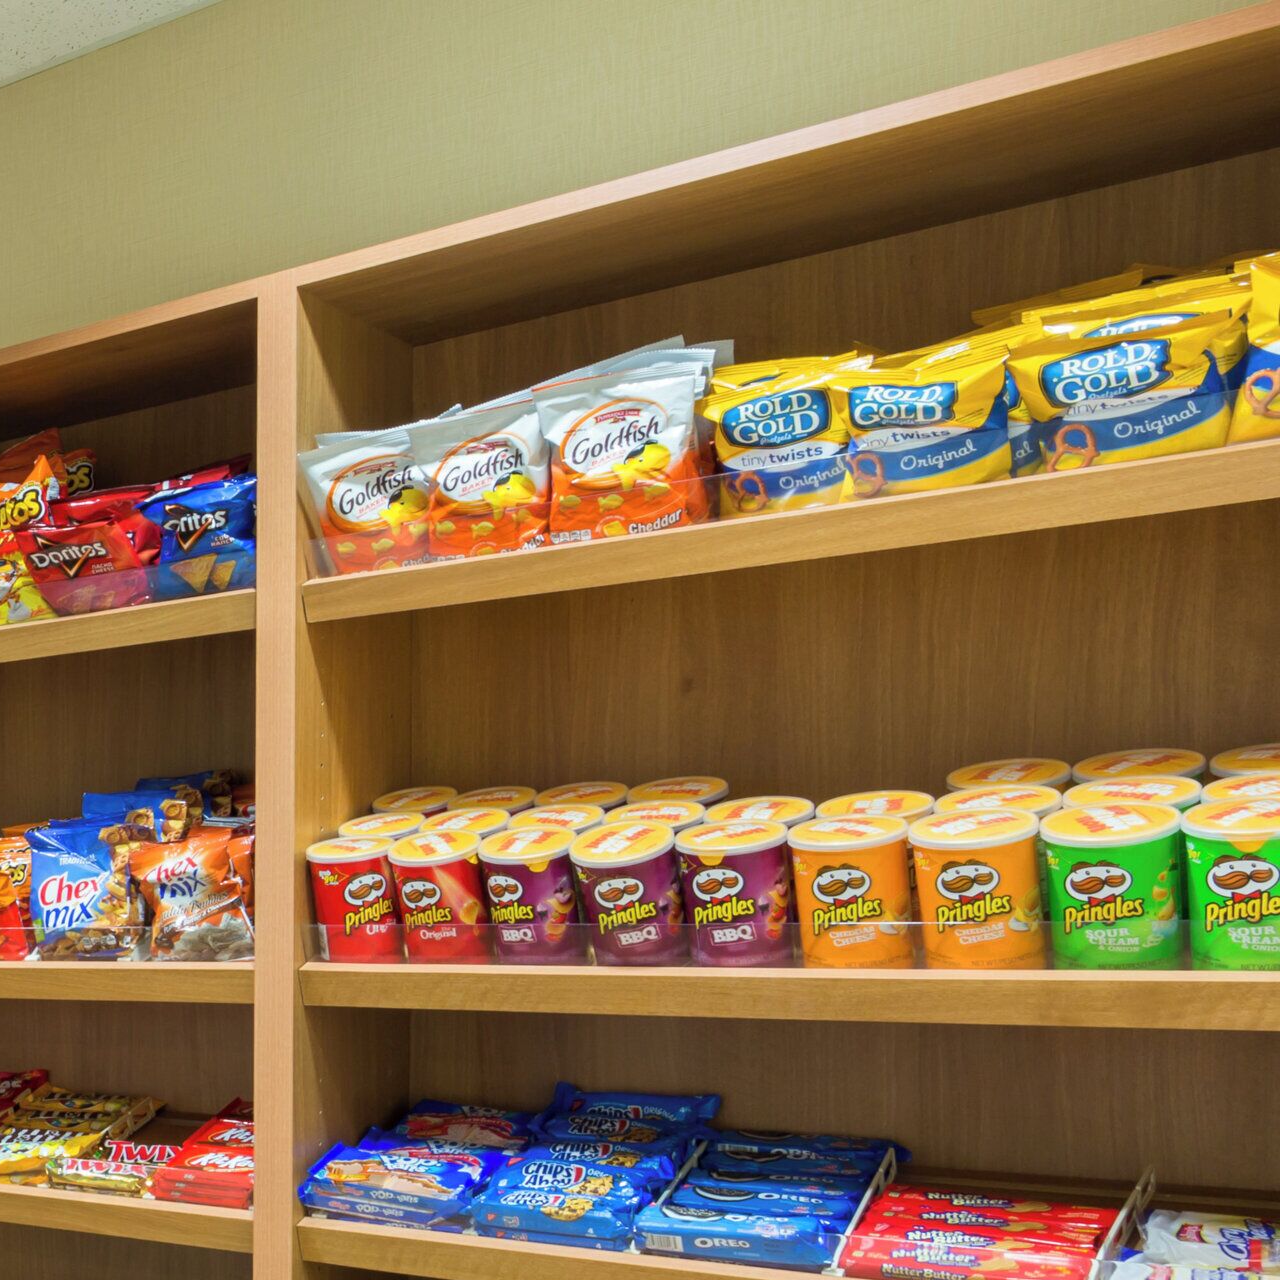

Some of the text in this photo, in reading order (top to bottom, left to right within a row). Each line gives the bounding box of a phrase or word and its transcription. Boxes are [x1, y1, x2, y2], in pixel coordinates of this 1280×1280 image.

[1061, 343, 1153, 378] ROLD
[864, 385, 940, 403] ROLD
[1055, 362, 1159, 404] GOLD
[740, 392, 812, 422] ROLD
[853, 402, 943, 428] GOLD
[1114, 401, 1200, 439] Original
[572, 416, 662, 465] Goldfish
[732, 410, 821, 445] GOLD
[891, 428, 951, 443] twists
[741, 445, 823, 468] tiny twists
[900, 439, 977, 472] Original
[443, 450, 524, 493] Goldfish
[780, 460, 848, 490] Original
[339, 465, 413, 517] Goldfish
[628, 508, 682, 535] Cheddar
[30, 541, 107, 567] Doritos
[143, 855, 197, 884] Chex
[40, 876, 102, 907] Chex
[158, 870, 207, 900] mix
[44, 896, 93, 930] mix
[345, 898, 394, 935] Pringles
[404, 907, 452, 933] Pringles
[598, 900, 657, 935] Pringles
[694, 897, 755, 930] Pringles
[813, 897, 883, 937] Pringles
[938, 894, 1013, 934] Pringles
[1064, 896, 1145, 935] Pringles
[419, 928, 457, 940] Original
[501, 927, 534, 942] BBQ
[619, 926, 658, 947] BBQ
[711, 925, 754, 945] BBQ
[1085, 926, 1130, 939] SOUR
[1090, 934, 1140, 946] CREAM
[1227, 925, 1275, 939] SOUR
[523, 1162, 572, 1181] Chips
[757, 1192, 824, 1205] OREO
[694, 1236, 751, 1249] OREO
[882, 1263, 922, 1279] Nutter
